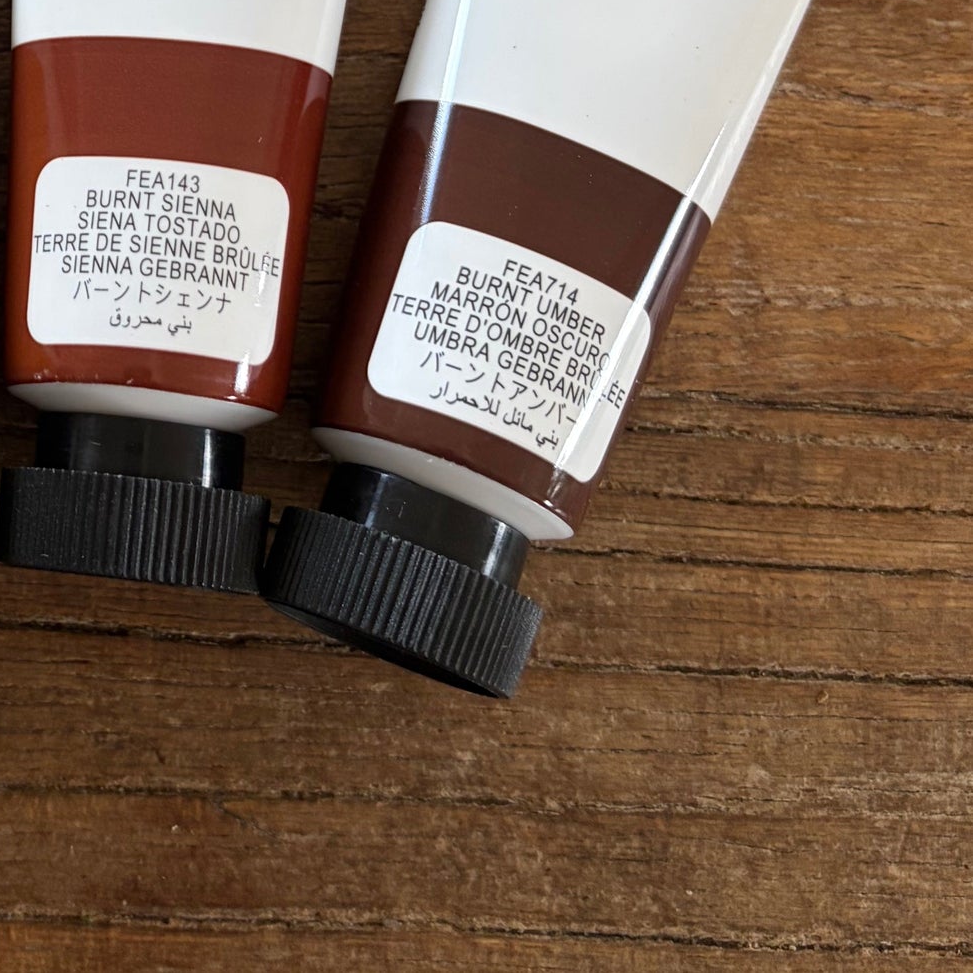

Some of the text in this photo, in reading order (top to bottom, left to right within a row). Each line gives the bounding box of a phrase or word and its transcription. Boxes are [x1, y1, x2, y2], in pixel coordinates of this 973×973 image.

[126, 169, 201, 193] FEA143
[86, 190, 236, 222] BURNT SIENNA
[77, 211, 241, 244] SIENA TOSTADO
[34, 233, 281, 278] TERRE DE SIENNE BRÛLÉE
[61, 255, 250, 292] SIENNA GEBRANNT
[73, 278, 232, 314] バーントシェンナ
[502, 259, 579, 304] FEA714
[109, 307, 193, 337] بني محروق
[456, 266, 605, 344] BURNT UMBER
[391, 293, 461, 327] TERRE
[465, 316, 564, 369] D'OMBRE
[414, 322, 489, 362] UMBRA
[430, 281, 610, 370] MARRÓN OSCURO
[503, 407, 534, 432] مائل
[535, 429, 559, 451] بني
